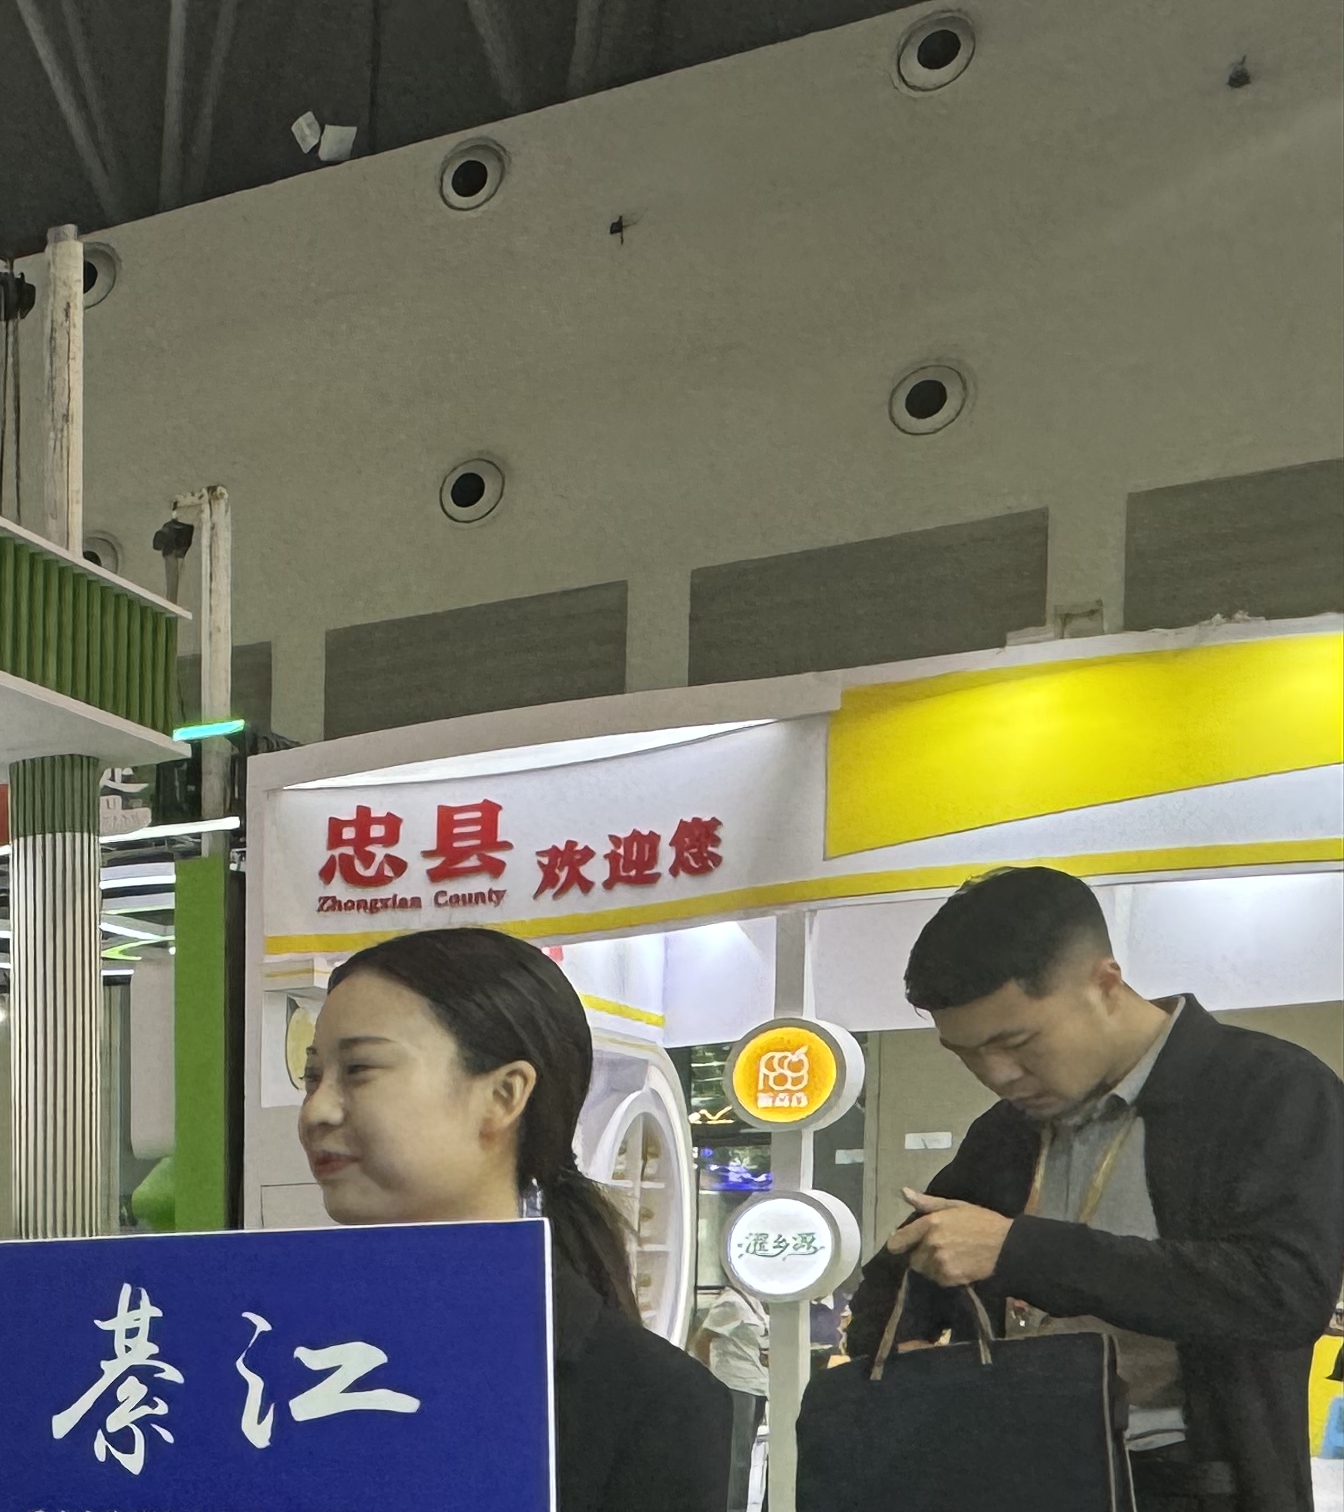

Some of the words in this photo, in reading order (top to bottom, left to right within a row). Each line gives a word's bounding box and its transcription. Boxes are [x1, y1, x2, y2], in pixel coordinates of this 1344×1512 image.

[318, 798, 515, 888] 忠县
[532, 816, 724, 900] 欢迎您
[316, 893, 423, 915] Zhongxian
[432, 888, 508, 910] County
[51, 1282, 421, 1476] 綦江
